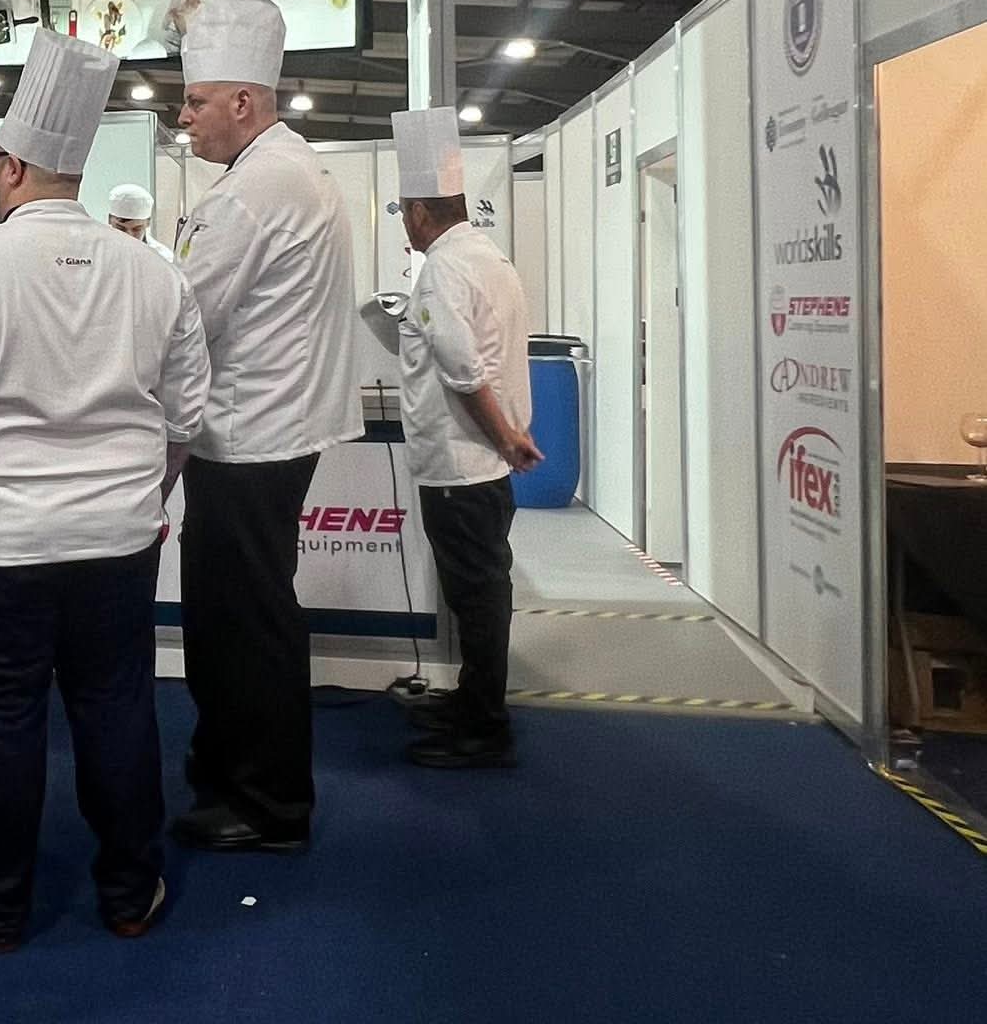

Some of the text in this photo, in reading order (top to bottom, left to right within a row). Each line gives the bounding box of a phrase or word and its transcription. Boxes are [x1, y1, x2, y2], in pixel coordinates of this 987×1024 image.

[470, 218, 495, 227] skills
[788, 296, 851, 317] STEPHENS
[790, 440, 837, 517] ifex
[298, 507, 407, 533] HENS
[297, 536, 401, 555] quipment
